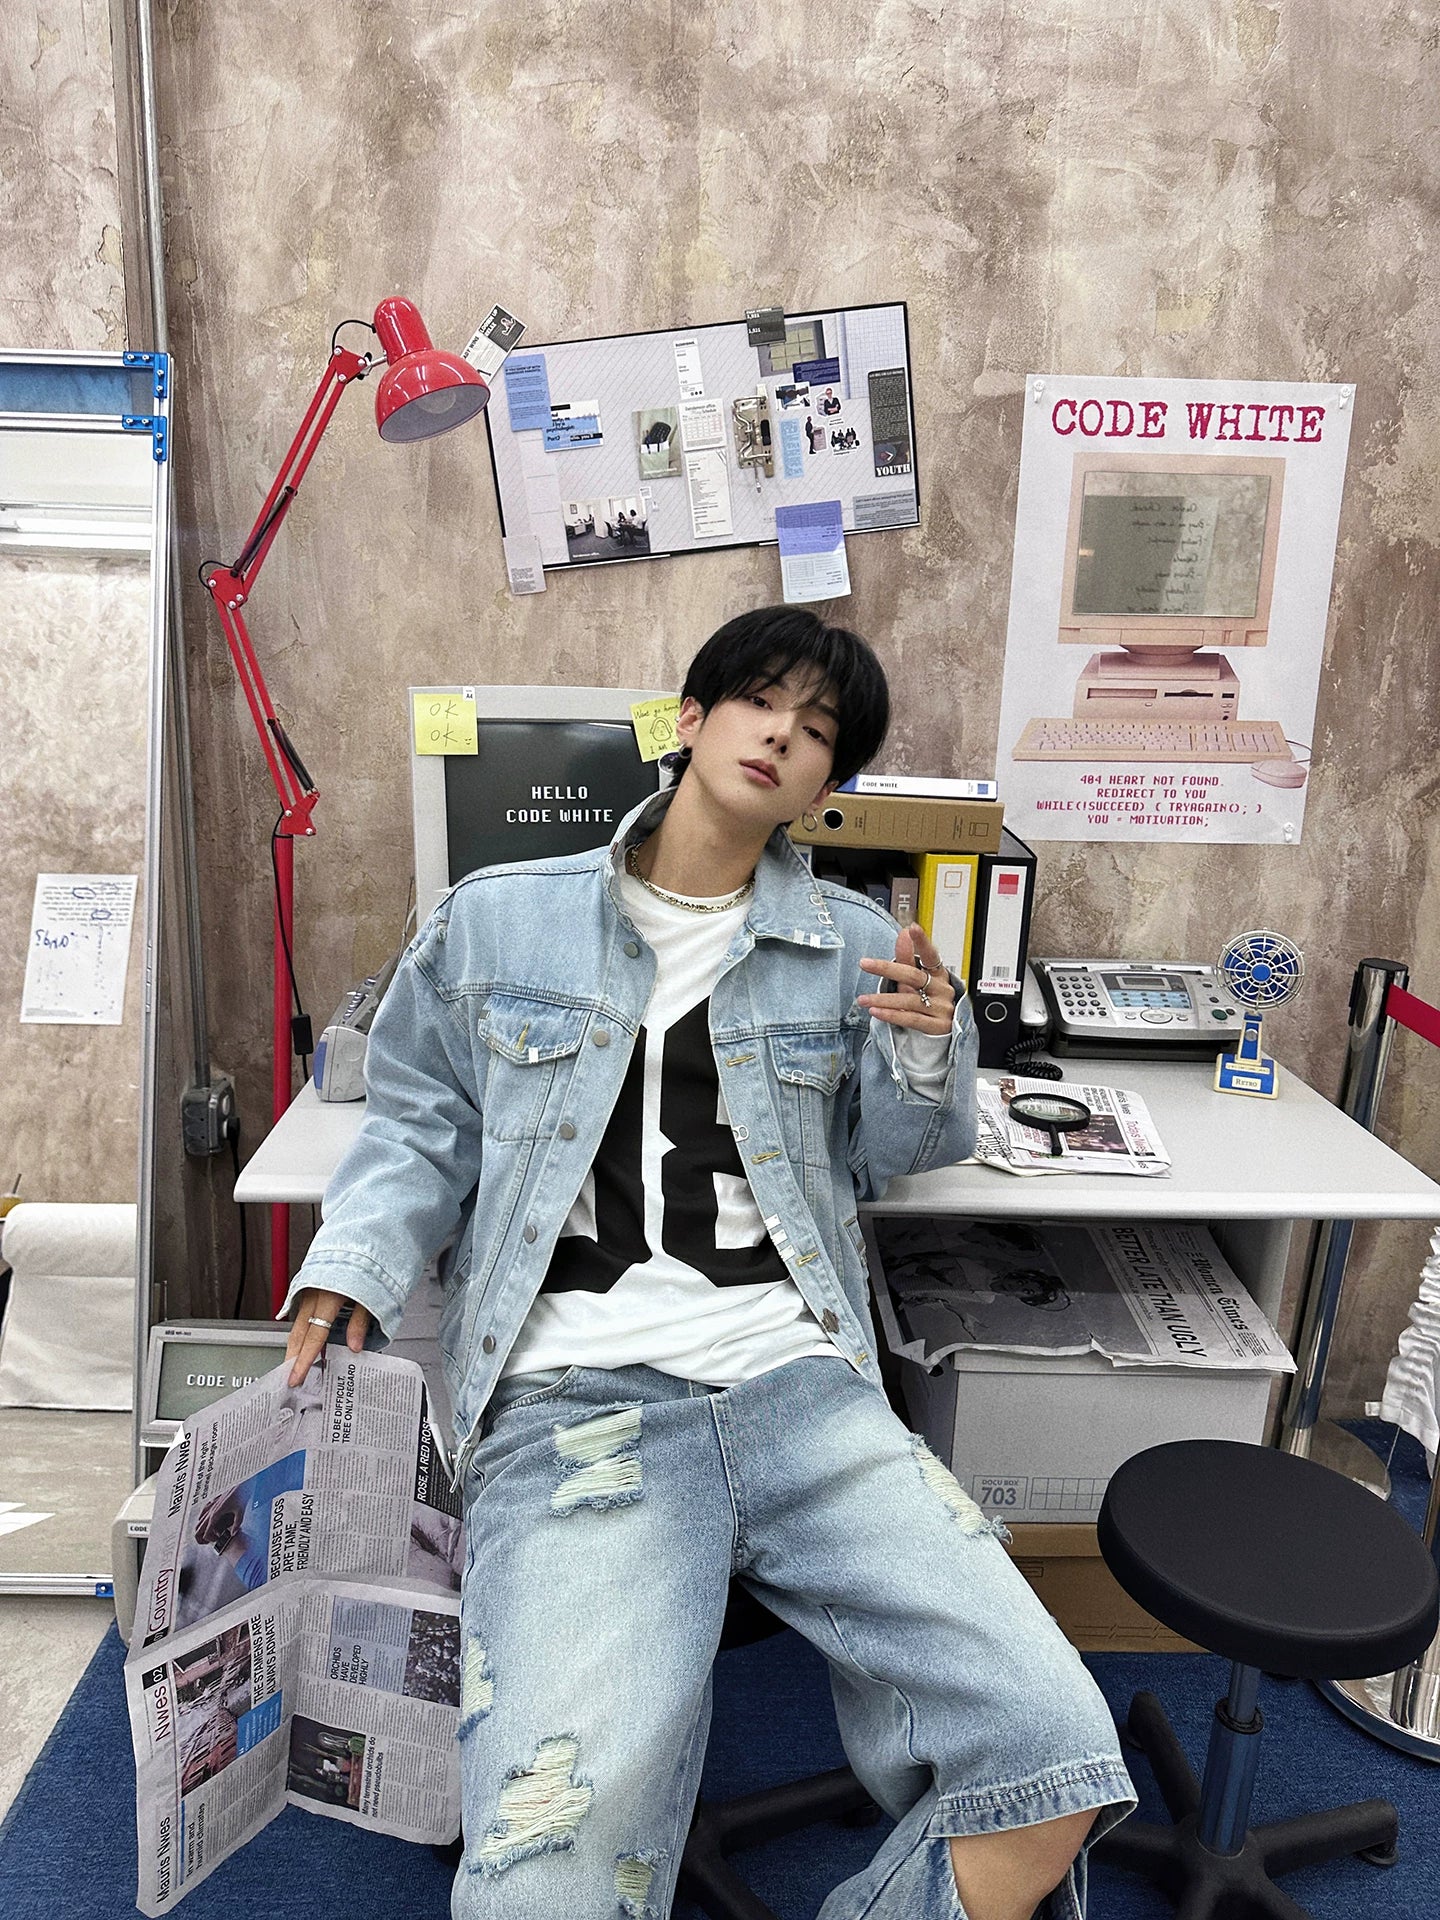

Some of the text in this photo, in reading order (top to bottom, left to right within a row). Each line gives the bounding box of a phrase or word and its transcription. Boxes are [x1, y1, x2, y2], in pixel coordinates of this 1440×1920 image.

[1051, 398, 1326, 442] CODE WHITE
[876, 463, 911, 476] YOUTH
[430, 700, 459, 719] OK
[430, 723, 459, 747] OK
[531, 785, 588, 800] HELLO
[1080, 775, 1102, 785] 404
[1109, 775, 1146, 786] HEART
[1153, 775, 1175, 786] NOT
[1097, 788, 1207, 799] REDIRECT TO YOU
[506, 809, 613, 823] CODE WHITE
[1087, 814, 1109, 825] YOU
[1111, 1227, 1208, 1358] BETTER LATE THAN UGLY
[1216, 1296, 1249, 1331] Times
[186, 1374, 225, 1387] CODE
[342, 1363, 356, 1444] TREE ONLY REGARD
[332, 1432, 341, 1444] TO
[333, 1419, 342, 1431] BE
[420, 1444, 431, 1465] RED
[419, 1464, 429, 1474] A
[168, 1472, 187, 1518] Mauris
[417, 1474, 430, 1502] ROSE,
[981, 1487, 1017, 1505] 703
[271, 1497, 285, 1580] BECAUSE DOGS
[297, 1493, 314, 1571] FRIENDLY AND EASY
[283, 1520, 300, 1573] ARE TAME,
[150, 1566, 174, 1632] Country
[251, 1613, 264, 1705] THE STAMENS ARE
[265, 1615, 276, 1695] ALWAYS ADNATE
[330, 1646, 342, 1680] ORCHIDS
[349, 1644, 362, 1684] DEVELOPED
[340, 1661, 350, 1682] HAVE
[358, 1659, 369, 1685] HIGHLY
[153, 1665, 171, 1742] 02 Nwes
[367, 1745, 375, 1770] orchids
[187, 1822, 195, 1840] and
[195, 1803, 205, 1870] humid climates
[156, 1816, 171, 1904] Mauris Nwes
[187, 1840, 195, 1866] warm
